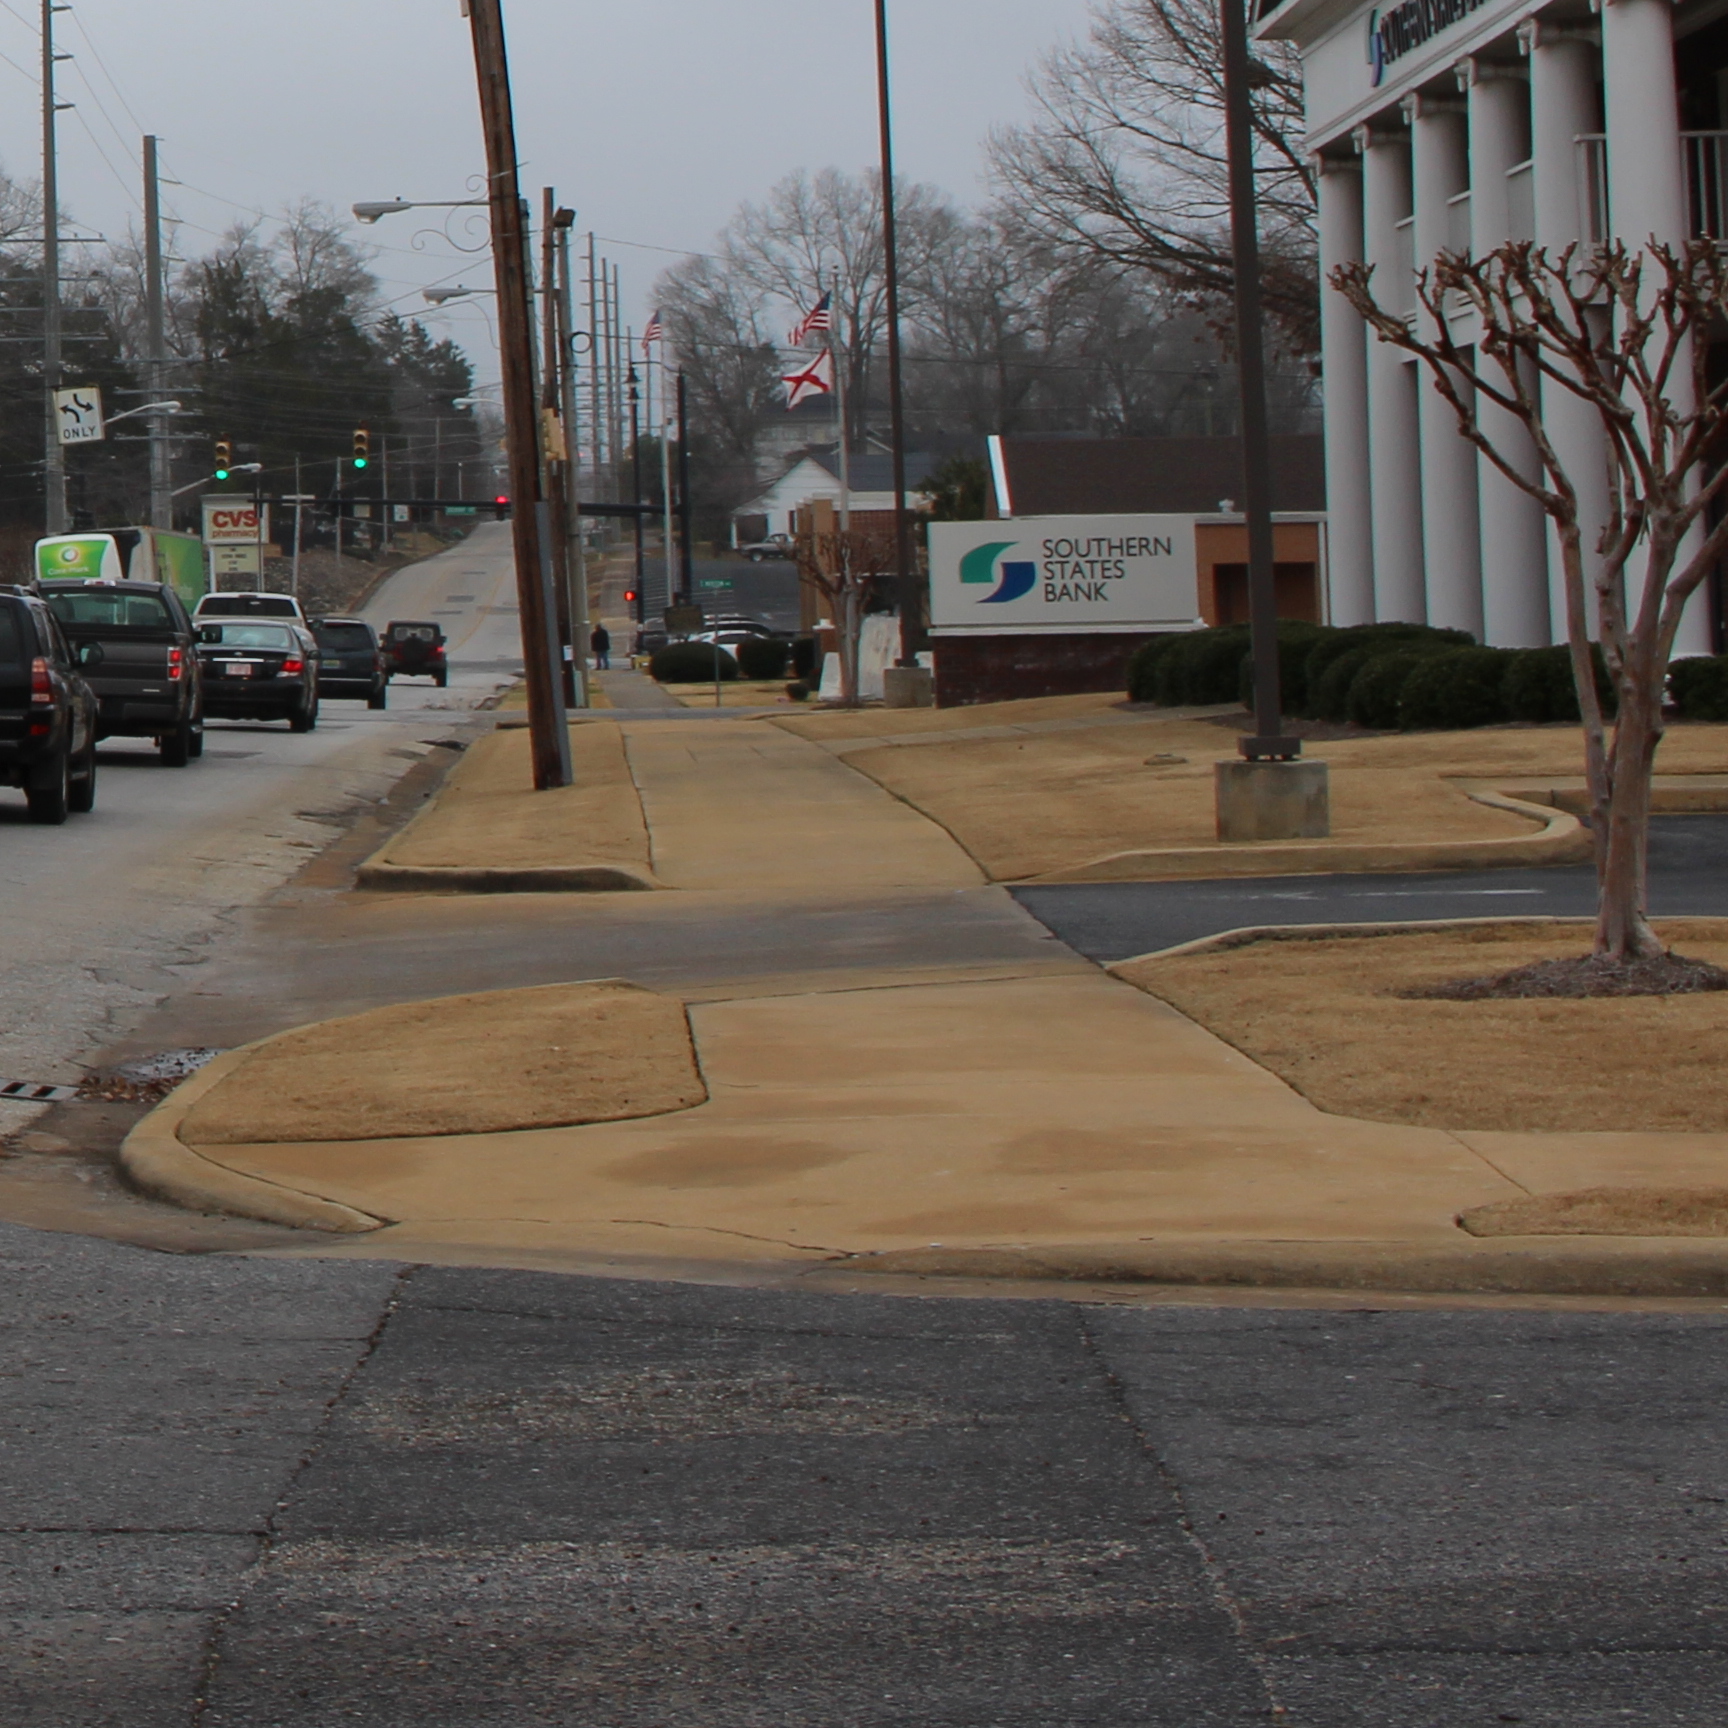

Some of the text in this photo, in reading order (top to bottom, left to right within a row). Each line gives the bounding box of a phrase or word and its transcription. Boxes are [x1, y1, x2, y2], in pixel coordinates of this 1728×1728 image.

[63, 425, 96, 439] ONLY
[212, 510, 259, 528] CVS
[1042, 536, 1172, 559] SOUTHERN
[1043, 559, 1125, 581] STATES
[1044, 581, 1108, 603] BANK
